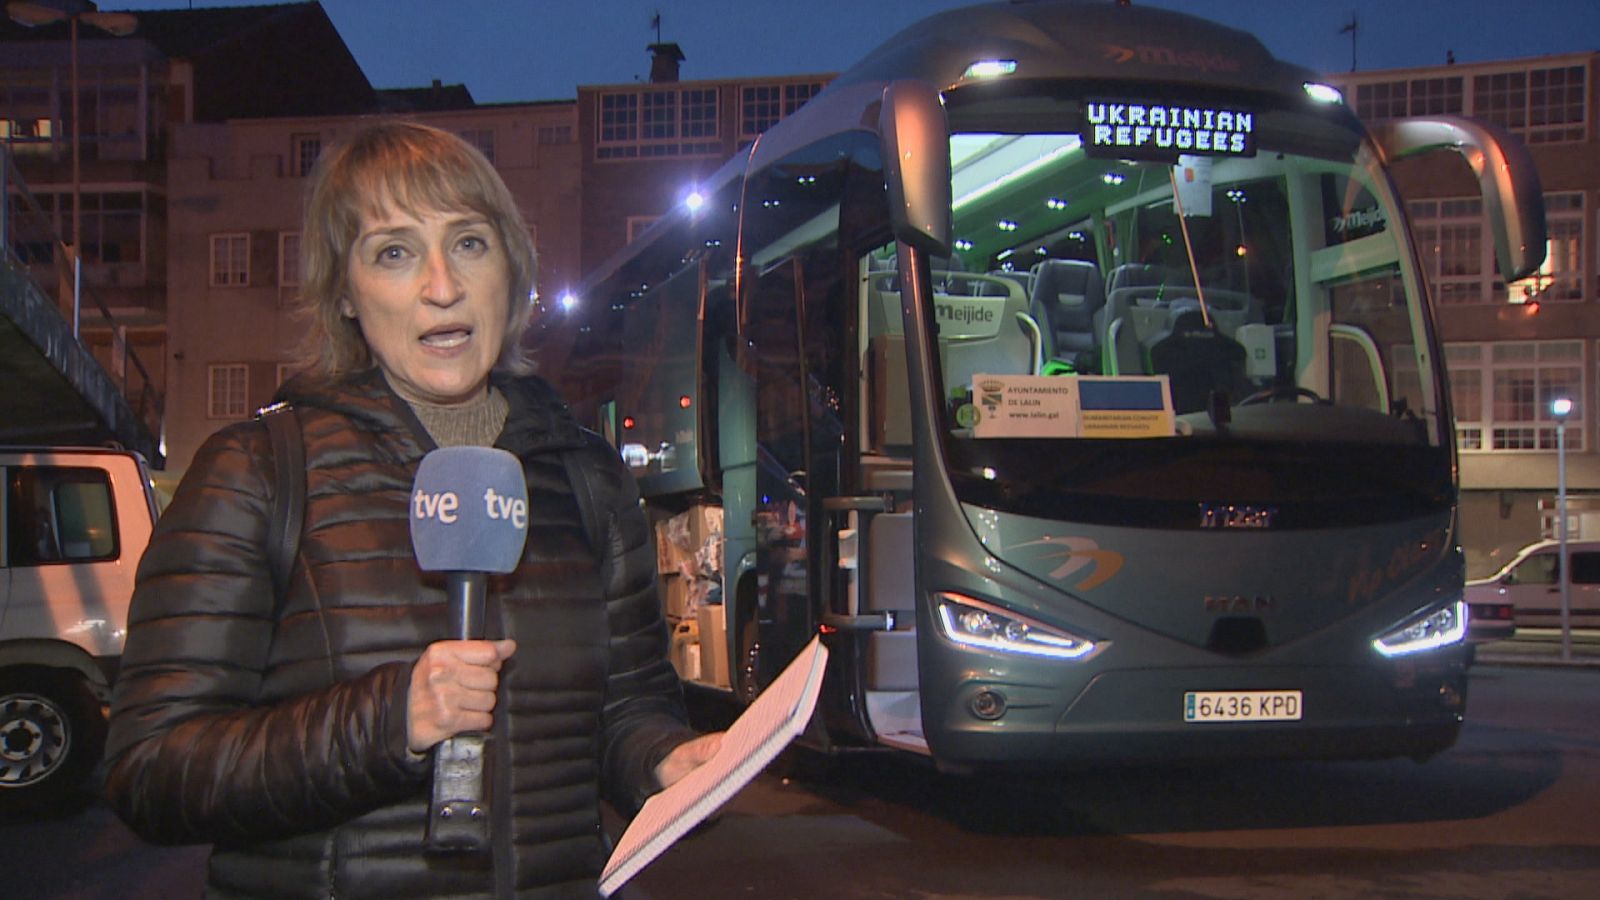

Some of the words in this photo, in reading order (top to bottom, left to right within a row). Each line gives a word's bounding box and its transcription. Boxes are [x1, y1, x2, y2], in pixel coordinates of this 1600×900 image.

[1087, 103, 1253, 133] UKRAINIAN
[1093, 124, 1246, 153] REFUGEES
[1008, 387, 1069, 395] AYUNTAMIENTO
[414, 489, 459, 524] tve
[484, 487, 526, 529] tve
[1199, 696, 1252, 717] 6436
[1259, 695, 1297, 717] KPD
